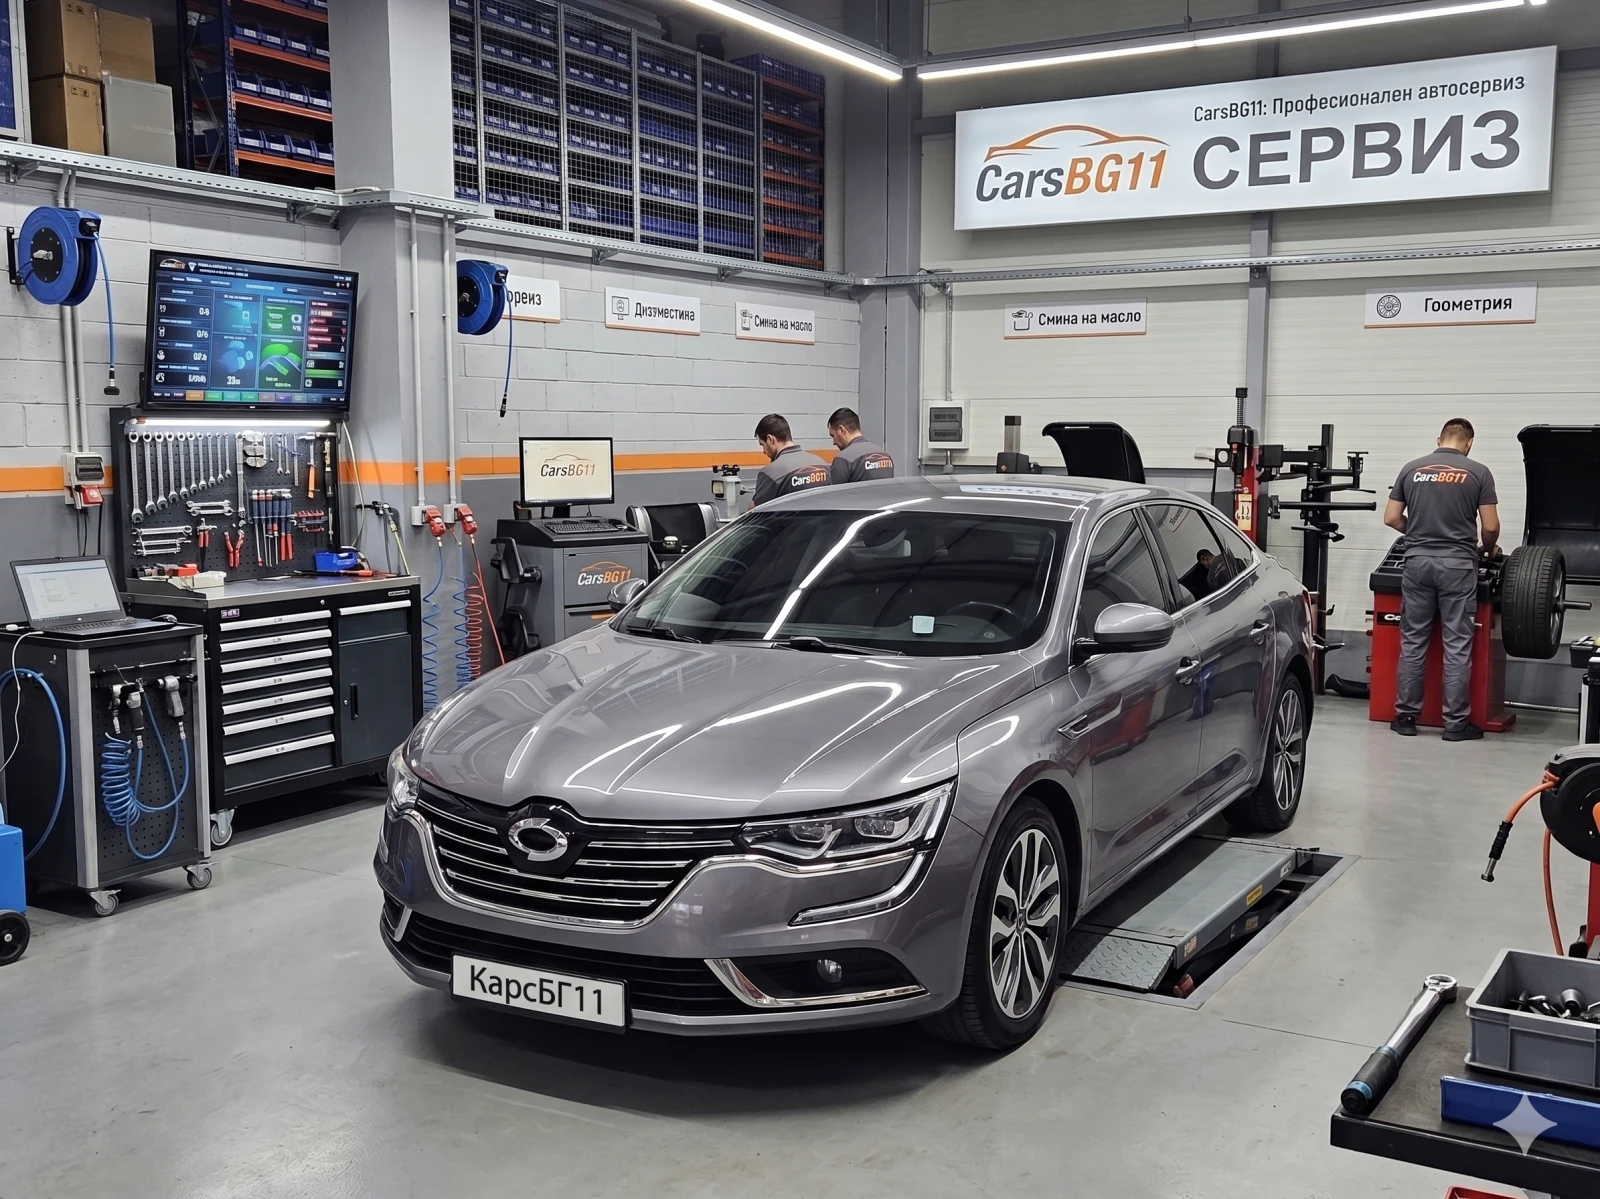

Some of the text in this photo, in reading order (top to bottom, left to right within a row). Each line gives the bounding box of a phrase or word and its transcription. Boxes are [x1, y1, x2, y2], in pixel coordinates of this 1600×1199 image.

[1193, 75, 1525, 122] CarsBG11: Професионален автосервиз
[1193, 109, 1520, 190] СЕРВИЗ
[976, 149, 1167, 202] CarsBG11
[779, 319, 789, 330] на
[790, 320, 813, 332] масло
[1038, 311, 1141, 326] Смина на масло
[540, 463, 596, 477] CarsBG11
[1413, 471, 1468, 484] CarsBG11
[577, 569, 632, 586] CarsBG11
[470, 964, 602, 1015] КарсБГ11
